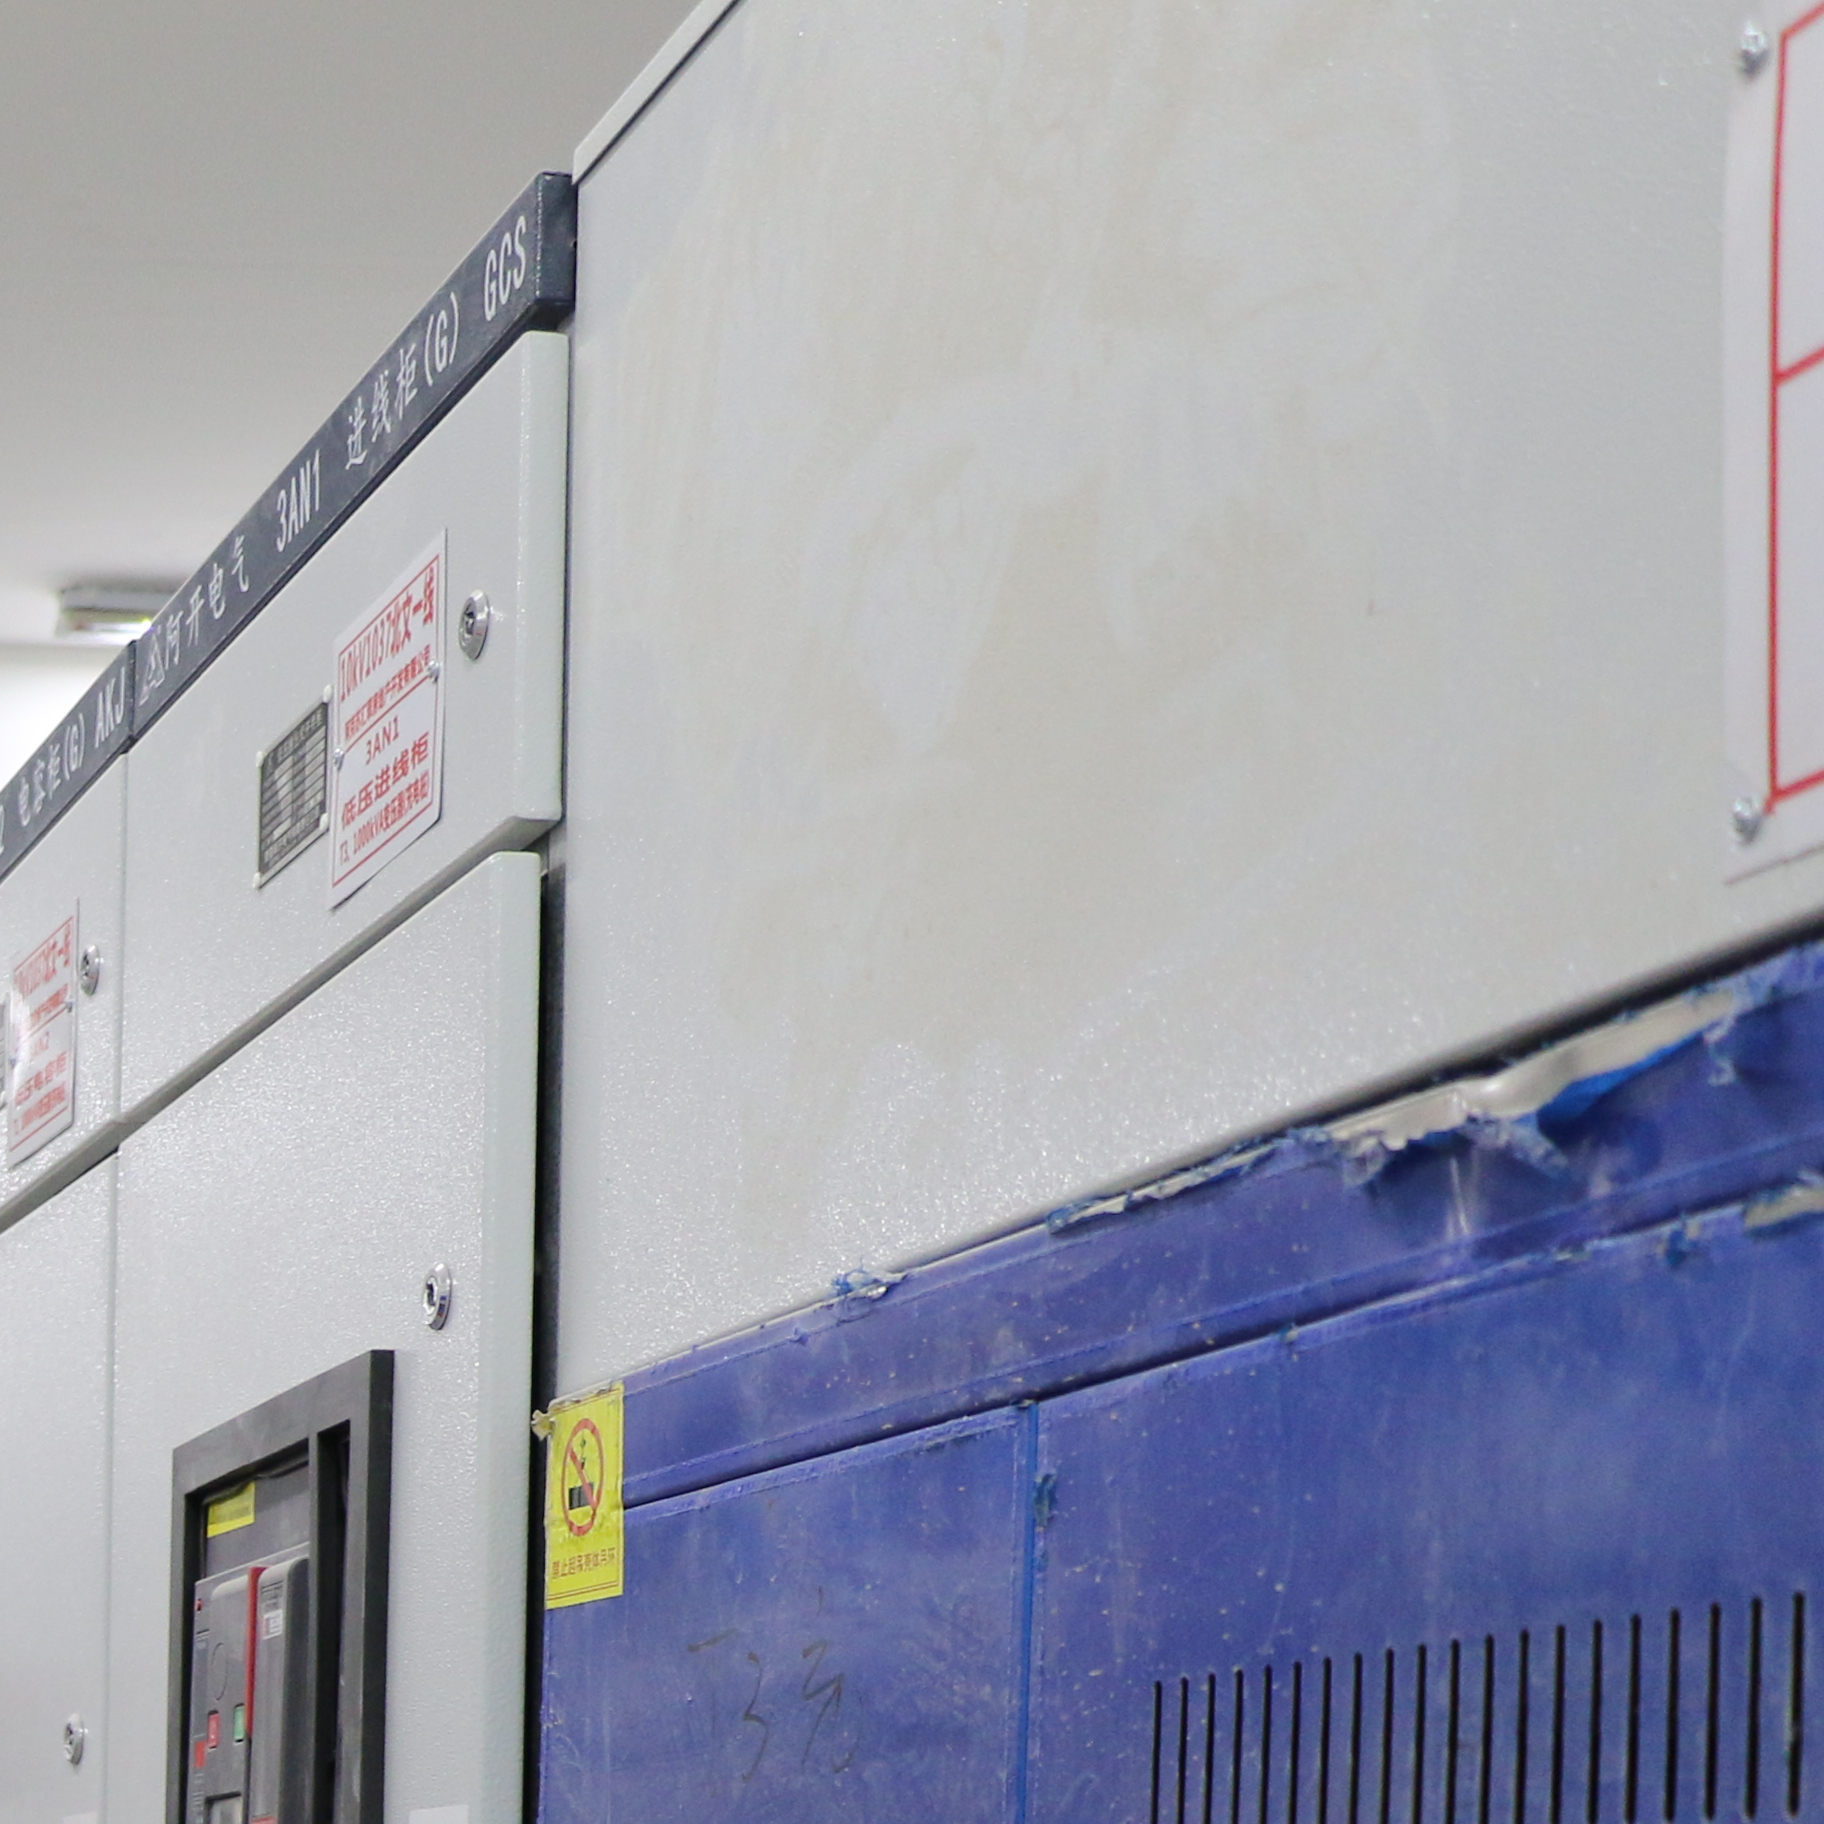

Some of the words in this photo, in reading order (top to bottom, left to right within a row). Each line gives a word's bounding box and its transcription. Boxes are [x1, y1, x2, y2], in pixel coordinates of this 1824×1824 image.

[164, 534, 250, 671] 阿开电气
[275, 449, 322, 553] 3AN1
[483, 215, 527, 322] GCS
[94, 666, 127, 749] AKJ
[365, 715, 401, 766] 3AN1
[341, 731, 429, 831] 低压进线柜
